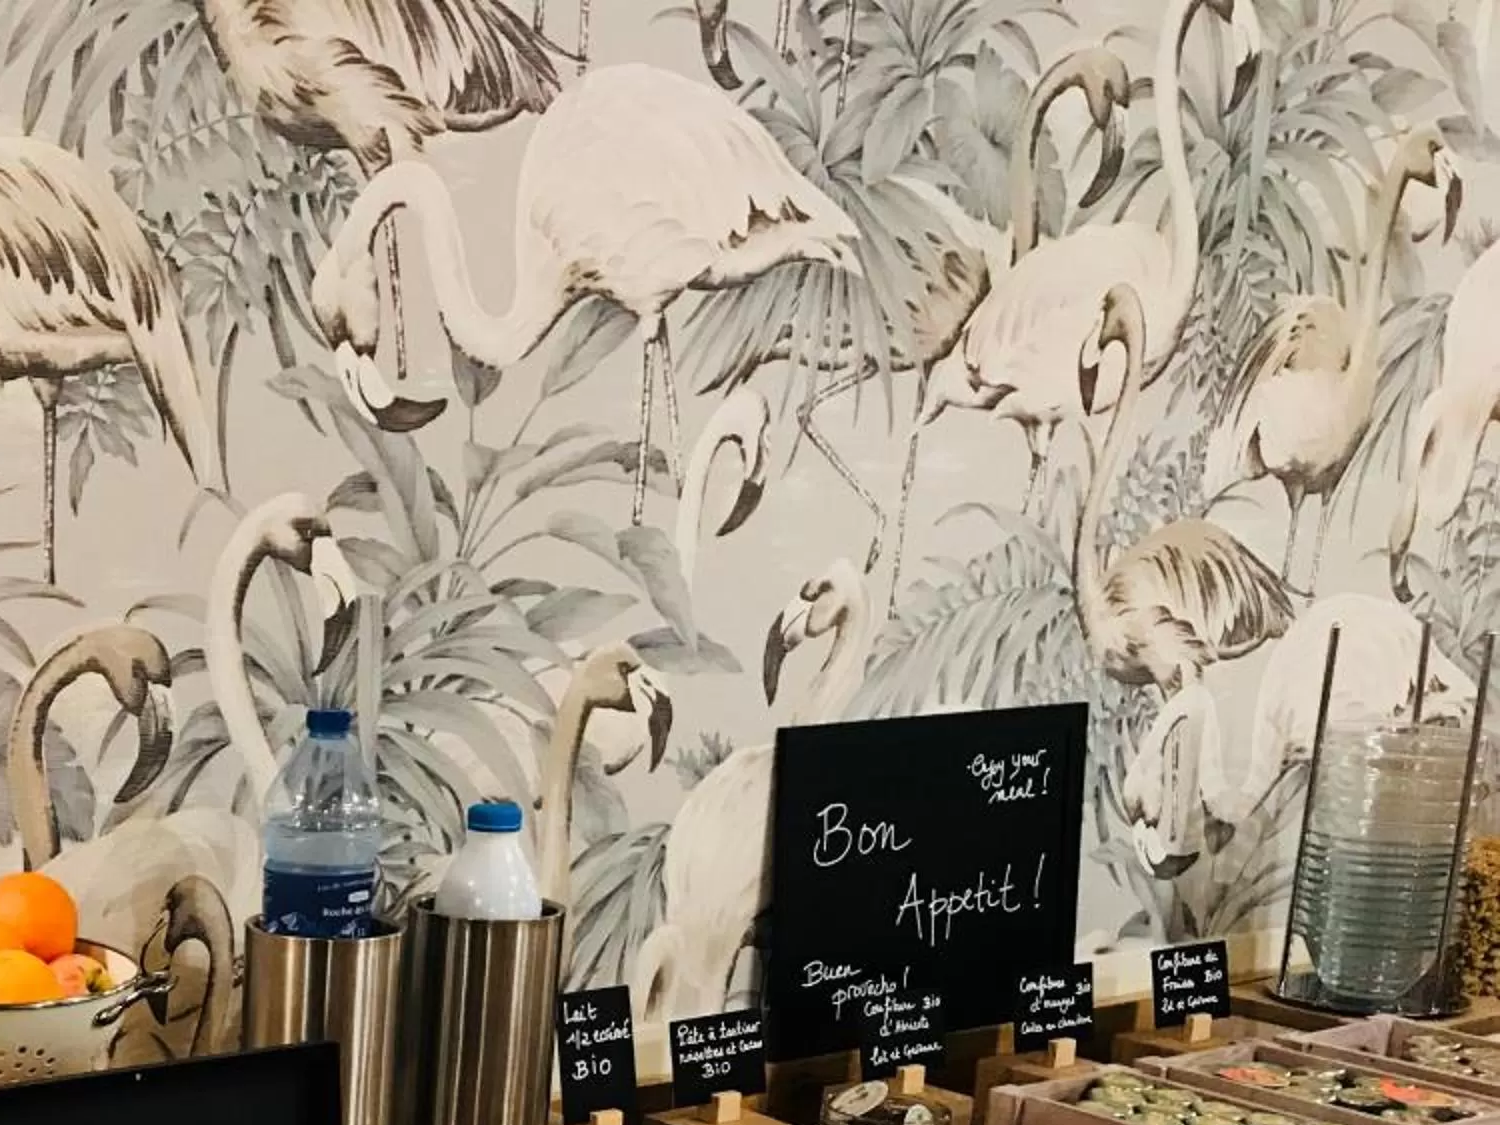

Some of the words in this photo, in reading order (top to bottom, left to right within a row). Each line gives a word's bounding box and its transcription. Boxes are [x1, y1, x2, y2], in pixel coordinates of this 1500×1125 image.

[813, 803, 913, 867] Bon
[801, 960, 862, 988] Buen
[563, 1001, 597, 1025] Lait
[565, 1029, 593, 1051] 1/2
